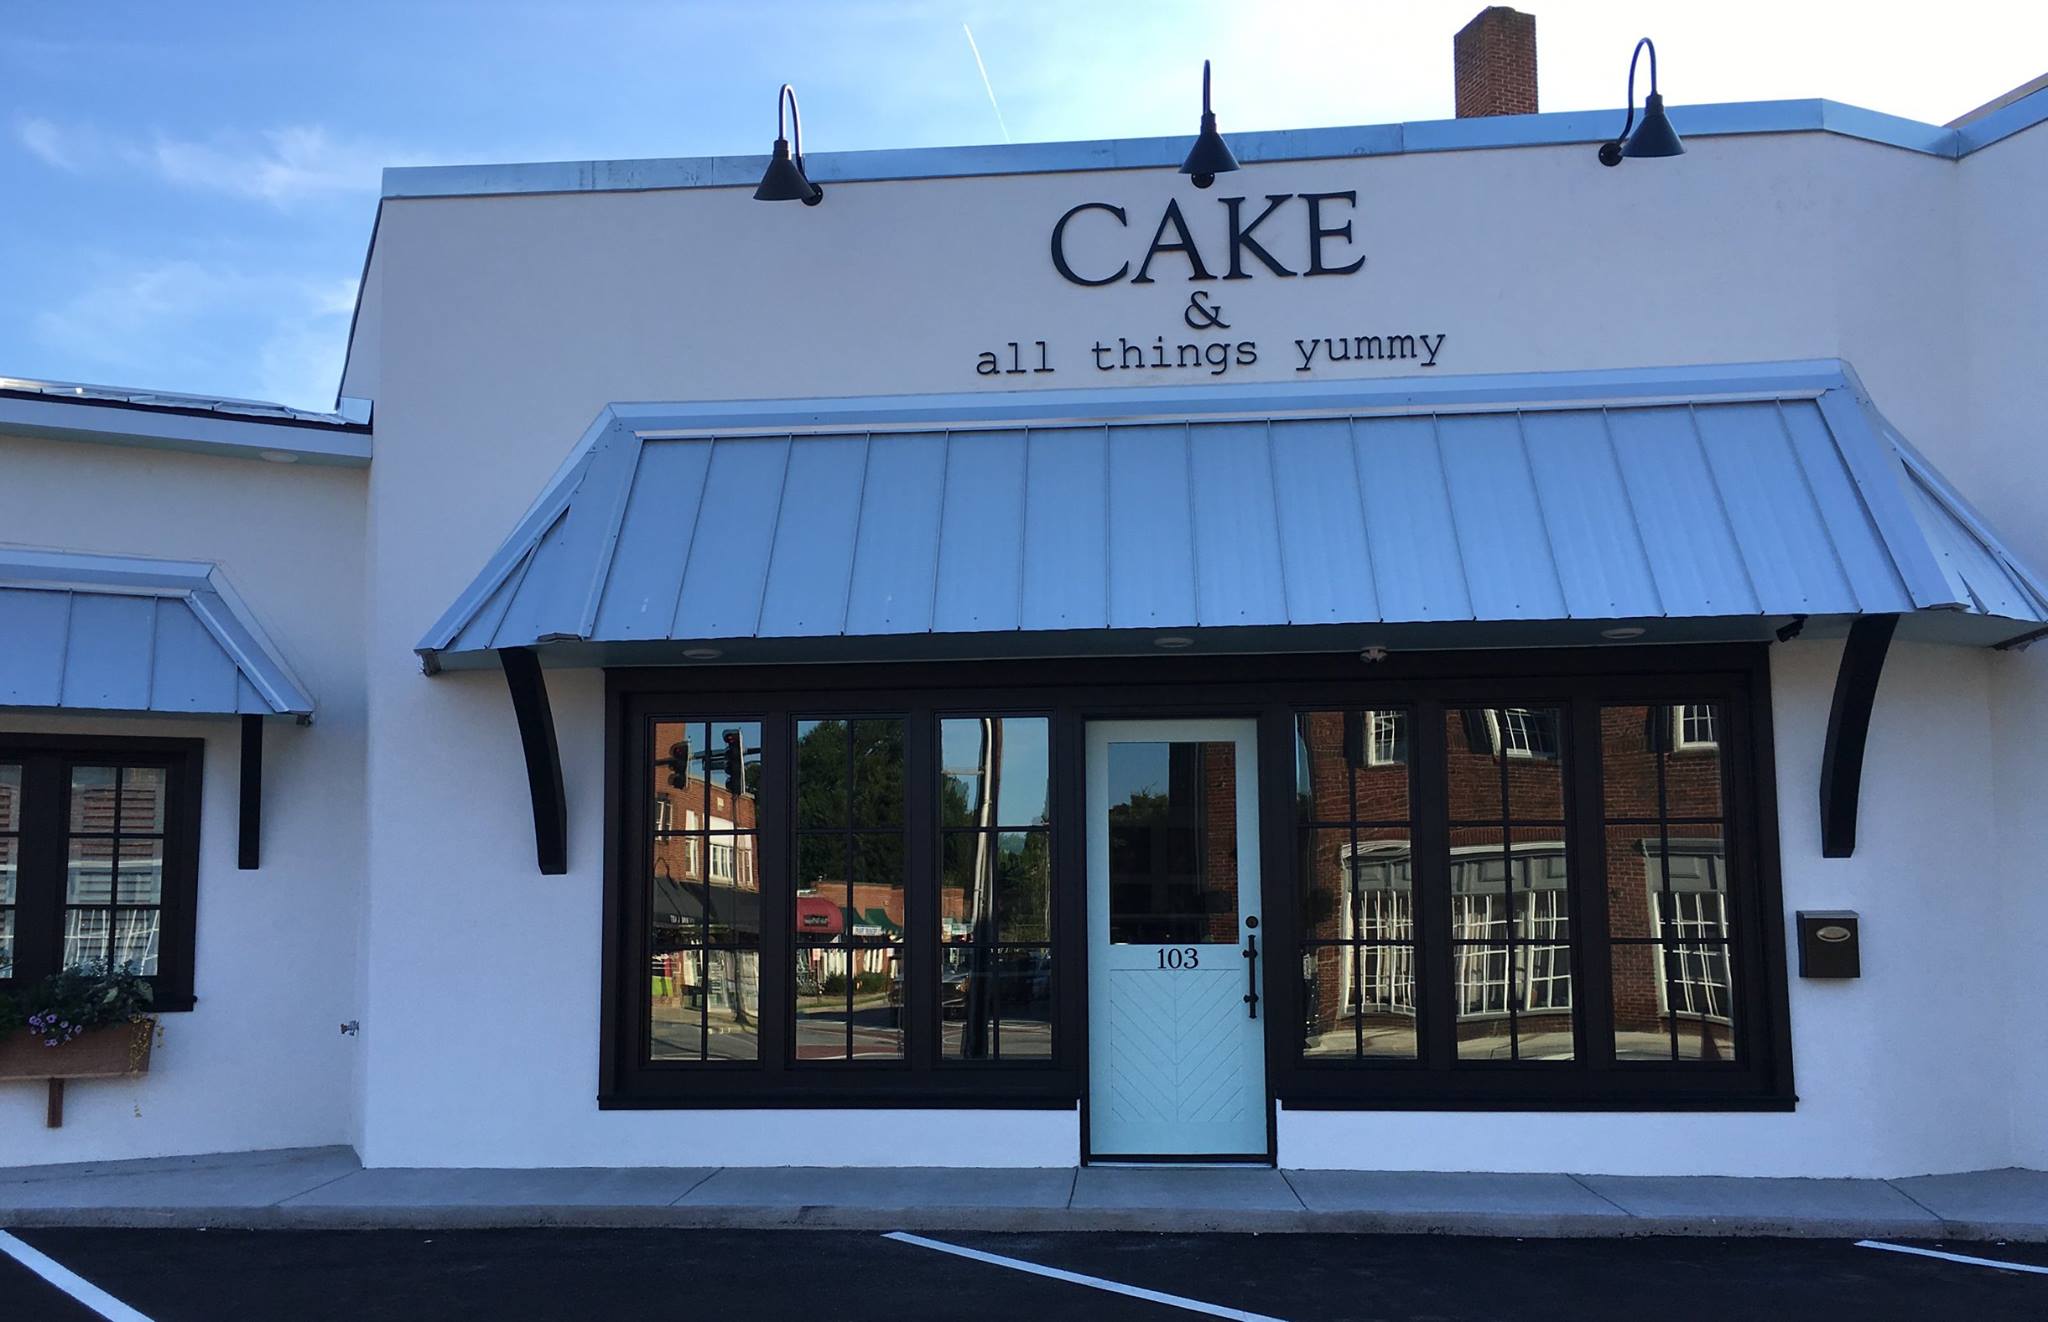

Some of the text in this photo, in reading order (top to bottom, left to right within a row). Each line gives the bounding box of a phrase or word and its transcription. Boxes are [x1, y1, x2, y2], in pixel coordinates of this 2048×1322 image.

[1051, 190, 1366, 287] CAKE
[1184, 291, 1231, 330] &
[976, 333, 1446, 376] all things yummy
[1157, 947, 1199, 969] 103
